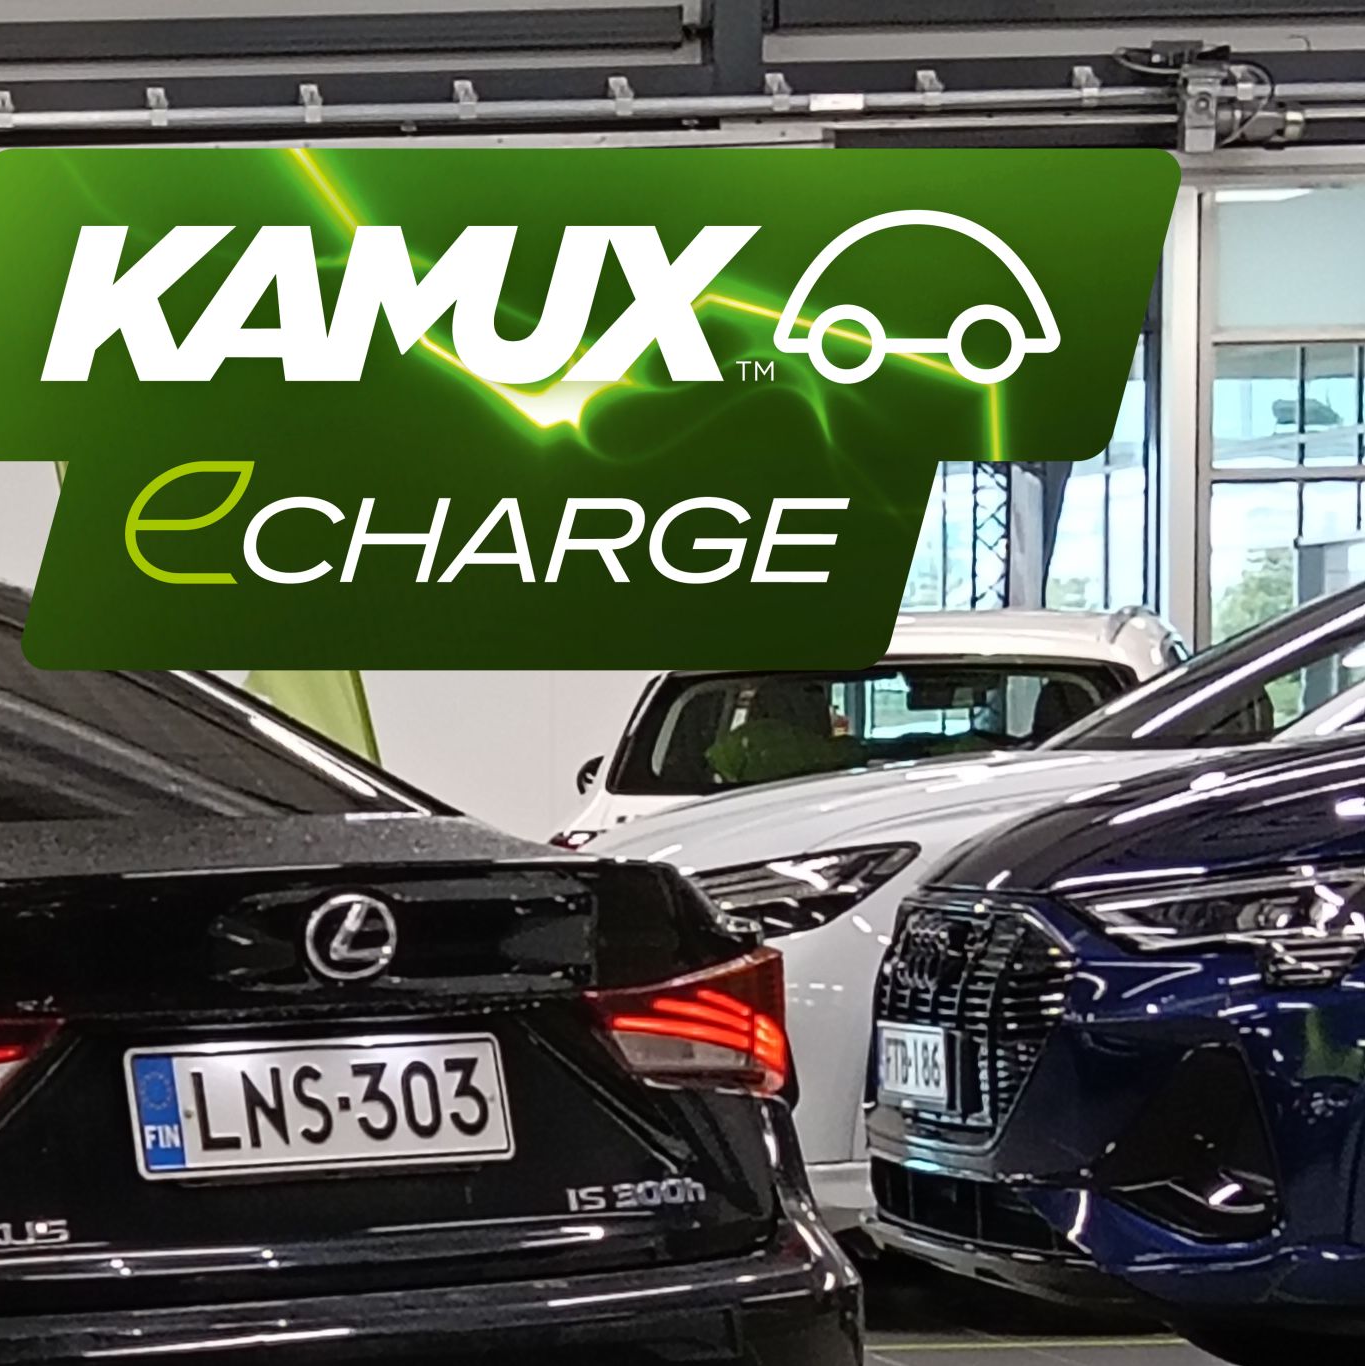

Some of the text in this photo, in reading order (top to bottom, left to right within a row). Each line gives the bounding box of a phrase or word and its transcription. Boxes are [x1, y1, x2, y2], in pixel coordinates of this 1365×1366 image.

[191, 1057, 489, 1151] LNS-303
[143, 1123, 181, 1150] FIN
[566, 1177, 706, 1212] IS 300h
